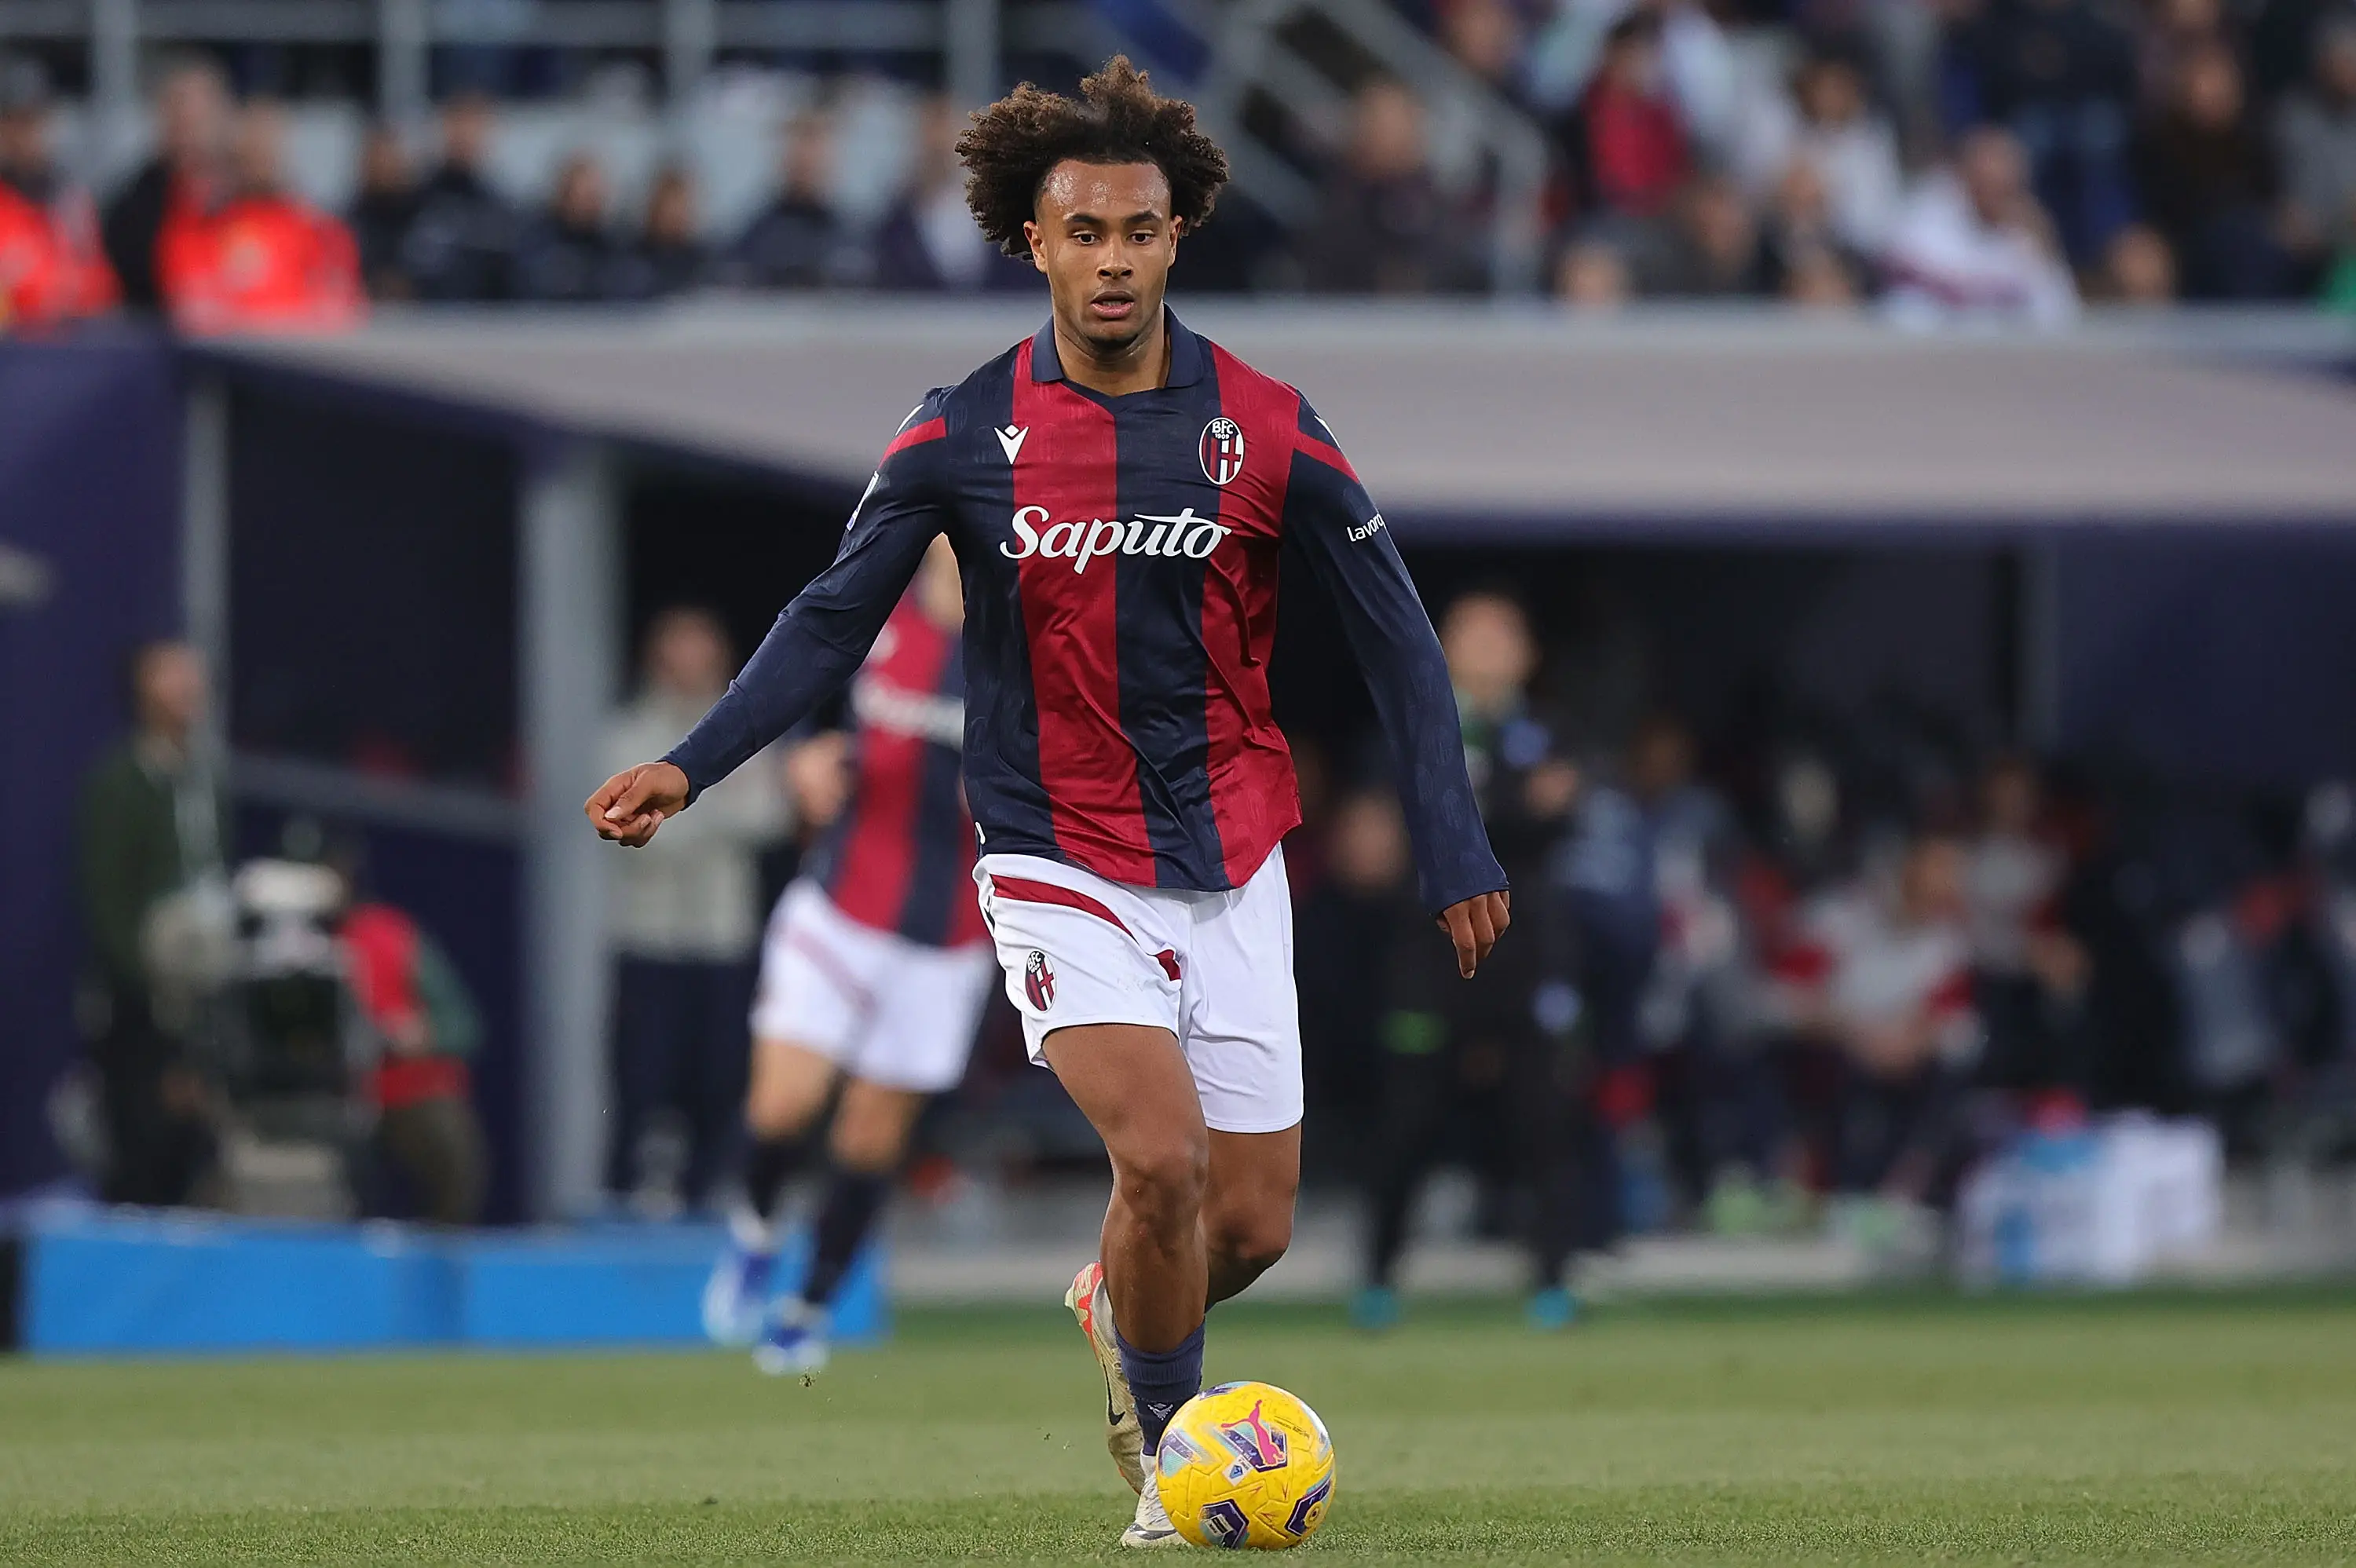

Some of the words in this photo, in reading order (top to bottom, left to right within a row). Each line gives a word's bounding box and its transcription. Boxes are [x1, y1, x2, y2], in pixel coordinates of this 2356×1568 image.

[1212, 419, 1234, 435] BFC
[999, 505, 1232, 575] Saputo
[1027, 952, 1041, 971] BFC
